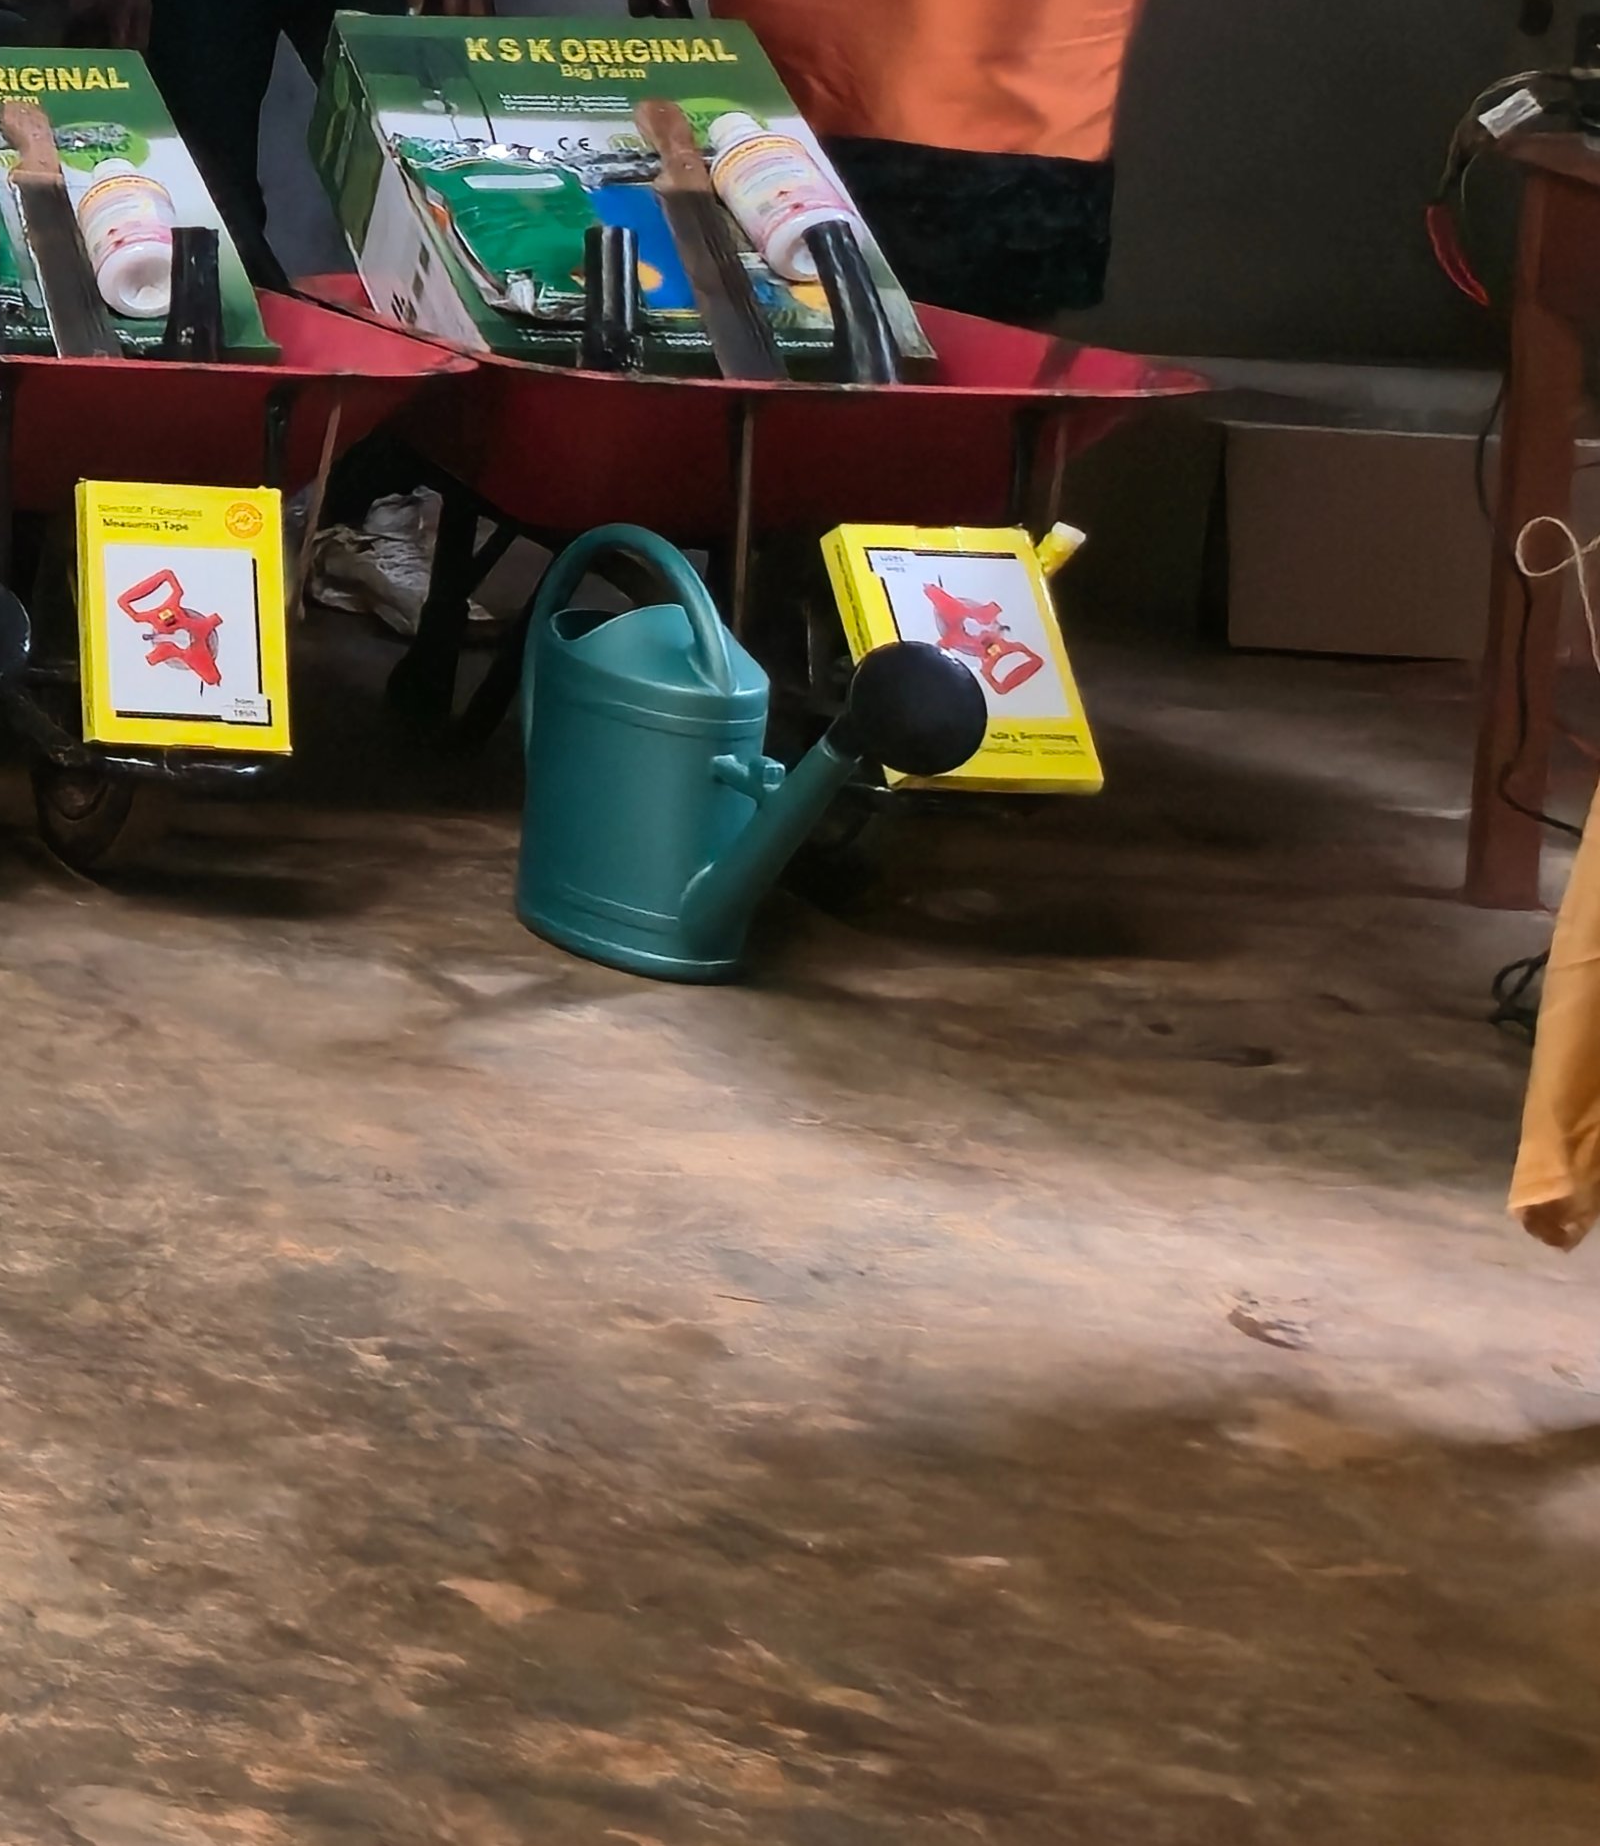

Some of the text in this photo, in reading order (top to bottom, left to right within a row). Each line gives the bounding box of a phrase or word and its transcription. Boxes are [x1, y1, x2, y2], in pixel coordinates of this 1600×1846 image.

[466, 37, 738, 64] K S K ORIGINAL
[560, 64, 647, 81] Big Farm
[103, 518, 189, 531] Measuring Tape
